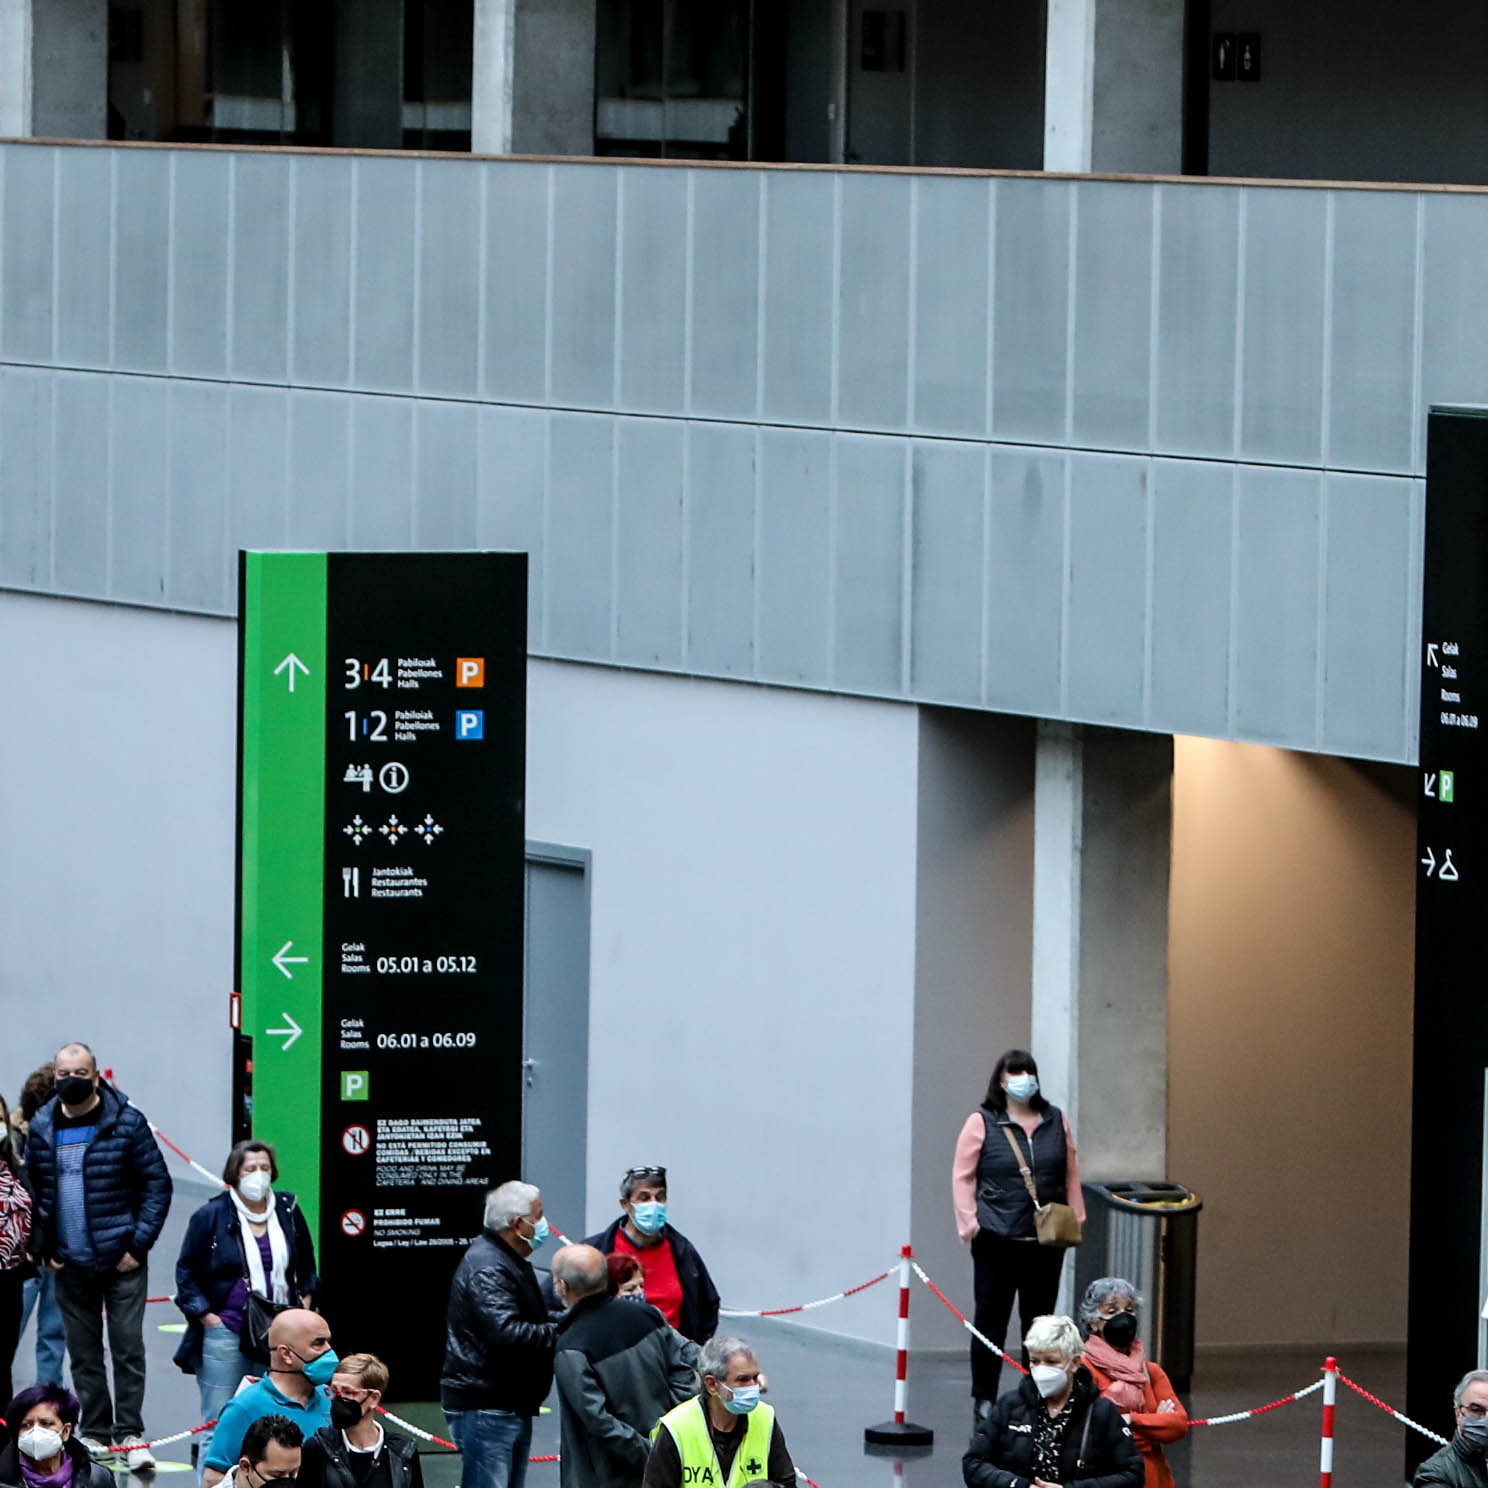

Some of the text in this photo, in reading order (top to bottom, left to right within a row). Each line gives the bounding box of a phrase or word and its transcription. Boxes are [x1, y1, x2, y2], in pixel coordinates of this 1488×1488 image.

[397, 669, 443, 678] Pabellones
[461, 661, 480, 684] P
[397, 680, 419, 688] Halls
[394, 721, 440, 731] Pabellones
[460, 713, 478, 736] P
[394, 732, 417, 741] Halls
[1442, 774, 1451, 799] P
[372, 867, 414, 876] Jantokiak
[371, 878, 428, 887] Restaurantes
[371, 888, 423, 897] Restaurants
[341, 942, 365, 952] Gelak
[341, 953, 363, 962] Salas
[341, 964, 371, 973] Rooms
[376, 955, 477, 974] 05.01 a 05.12
[340, 1018, 364, 1028] Gelak
[340, 1029, 362, 1038] Salas
[340, 1040, 370, 1049] Rooms
[376, 1032, 477, 1049] 06.01 a 06.09
[346, 1074, 363, 1097] P
